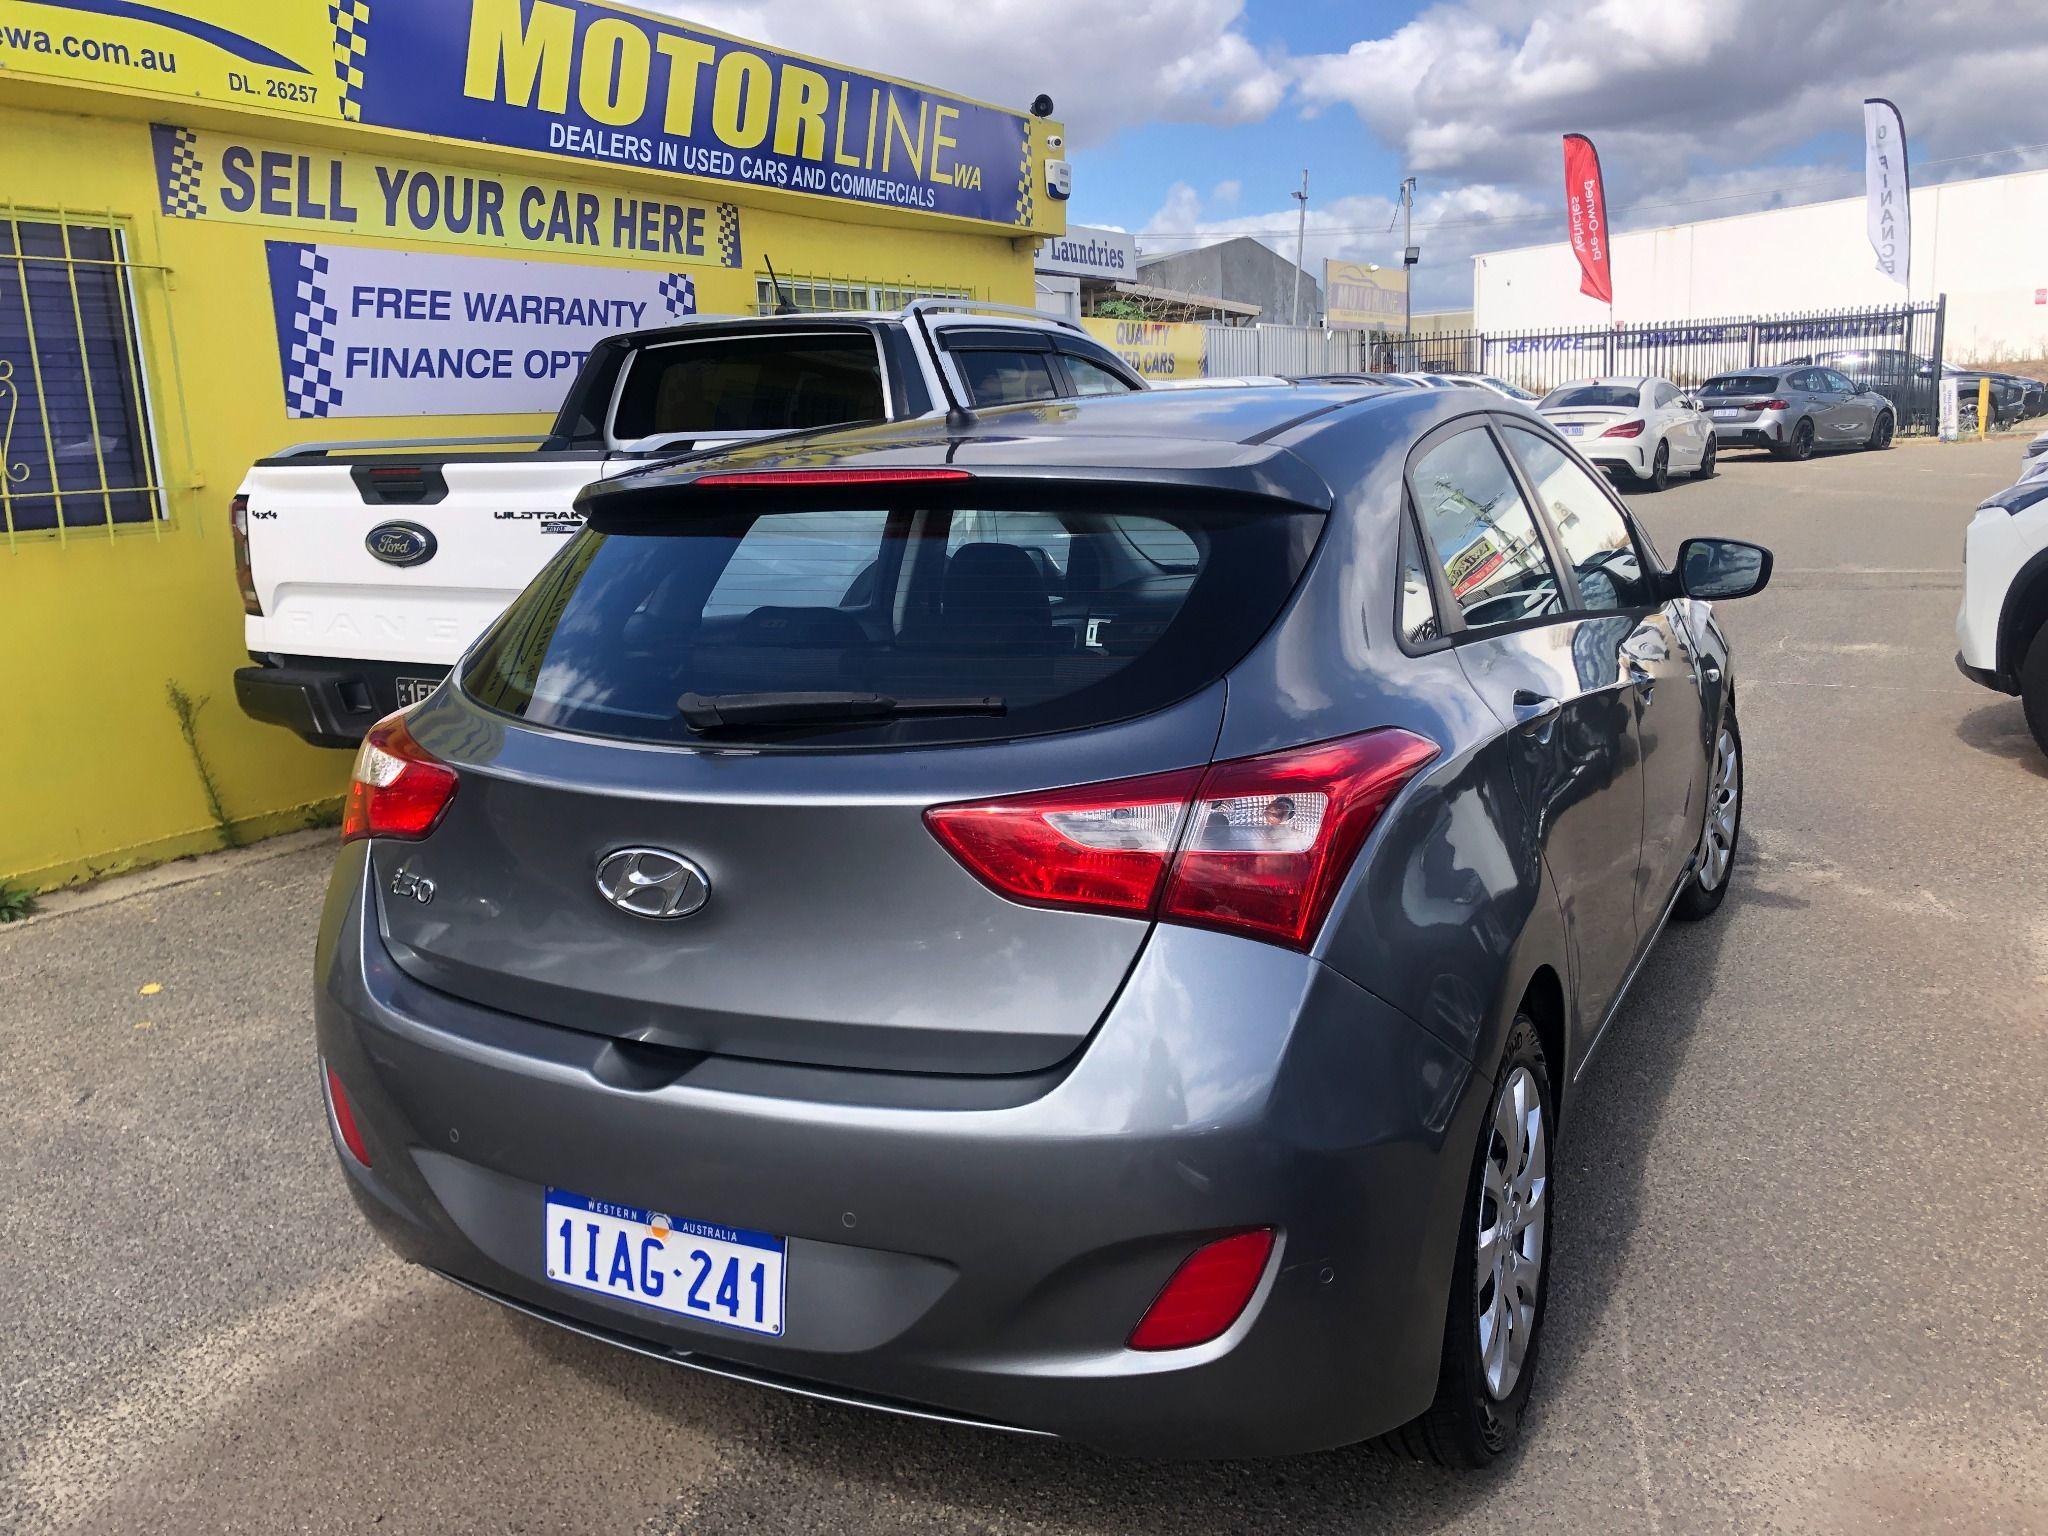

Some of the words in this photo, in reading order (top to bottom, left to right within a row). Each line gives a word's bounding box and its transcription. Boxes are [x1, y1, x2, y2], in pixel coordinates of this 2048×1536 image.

[0, 26, 176, 73] wa.com.au
[228, 72, 260, 95] DL.
[266, 79, 318, 104] 26257
[550, 122, 652, 164] DEALERS
[658, 140, 678, 168] IN
[684, 144, 735, 178] USED
[740, 155, 788, 186] CARS
[792, 165, 826, 192] AND
[830, 171, 936, 209] COMMERCIALS
[219, 146, 358, 223] SELL
[375, 166, 504, 237] YOUR
[518, 186, 599, 246] CAR
[614, 198, 705, 257] HERE
[1051, 237, 1125, 269] Laundries
[351, 286, 451, 322] FREE
[463, 292, 647, 328] WARRANTY
[1116, 321, 1171, 346] QUALITY
[1506, 335, 1585, 354] SERVICE
[345, 347, 513, 380] FINANCE
[1144, 352, 1175, 375] CARS
[494, 511, 582, 520] WILDTRAK
[378, 534, 410, 553] Ford
[587, 1200, 638, 1221] WESTERN
[682, 1222, 738, 1243] AUSTRALIA
